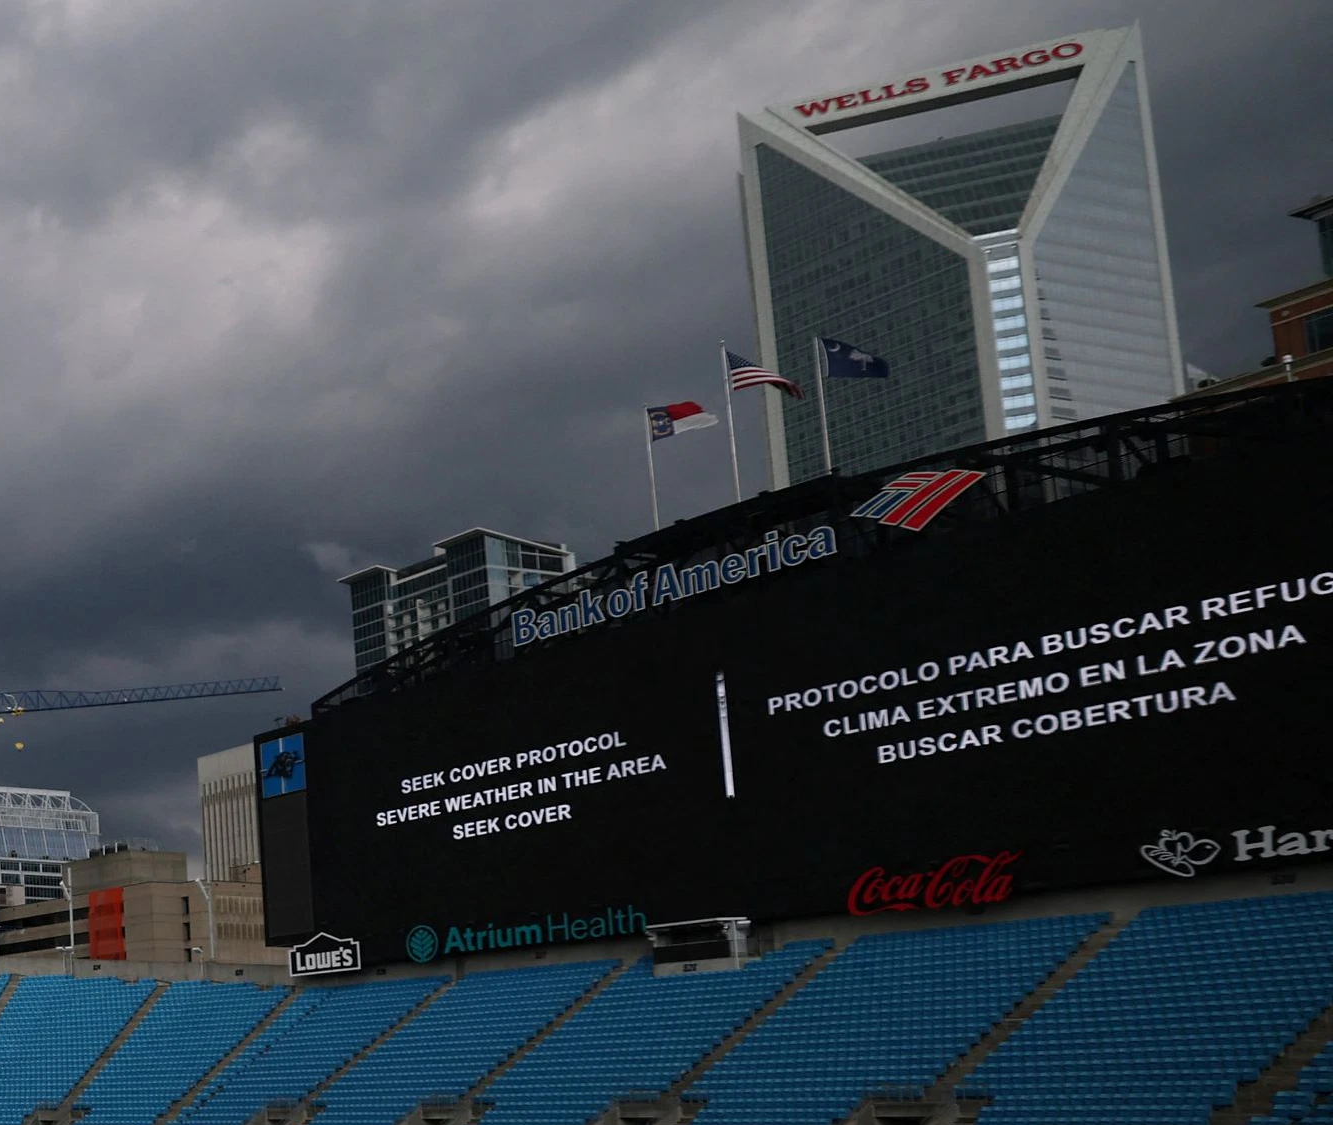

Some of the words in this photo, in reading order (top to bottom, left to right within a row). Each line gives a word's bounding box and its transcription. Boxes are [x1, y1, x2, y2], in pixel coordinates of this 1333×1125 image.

[795, 77, 930, 119] WELLS
[943, 42, 1084, 86] FARGO
[511, 586, 606, 648] Bank
[606, 572, 649, 620] of
[652, 524, 838, 607] America
[768, 661, 940, 715] PROTOCOLO
[948, 641, 1035, 676] PARA
[1041, 605, 1191, 656] BUSCAR
[1201, 572, 1333, 621] REFUG
[823, 705, 911, 737] CLIMA
[917, 672, 1070, 720] EXTREMO
[1079, 659, 1126, 687] EN
[1137, 649, 1186, 676] LA
[1194, 624, 1306, 665] ZONA
[877, 724, 1004, 764] BUSCAR
[1011, 681, 1236, 739] COBERTURA
[376, 800, 442, 827] SEVERE
[444, 781, 534, 813] WEATHER
[537, 776, 557, 794] IN
[561, 766, 602, 789] THE
[606, 754, 667, 781] AREA
[401, 771, 446, 794] SEEK
[449, 756, 512, 783] COVER
[516, 731, 627, 769] PROTOCOL
[452, 817, 501, 840] SEEK
[504, 804, 572, 830] COVER
[1231, 825, 1333, 862] Har
[296, 946, 353, 972] LOWE'S
[443, 920, 544, 956] Atrium
[546, 904, 648, 944] Health
